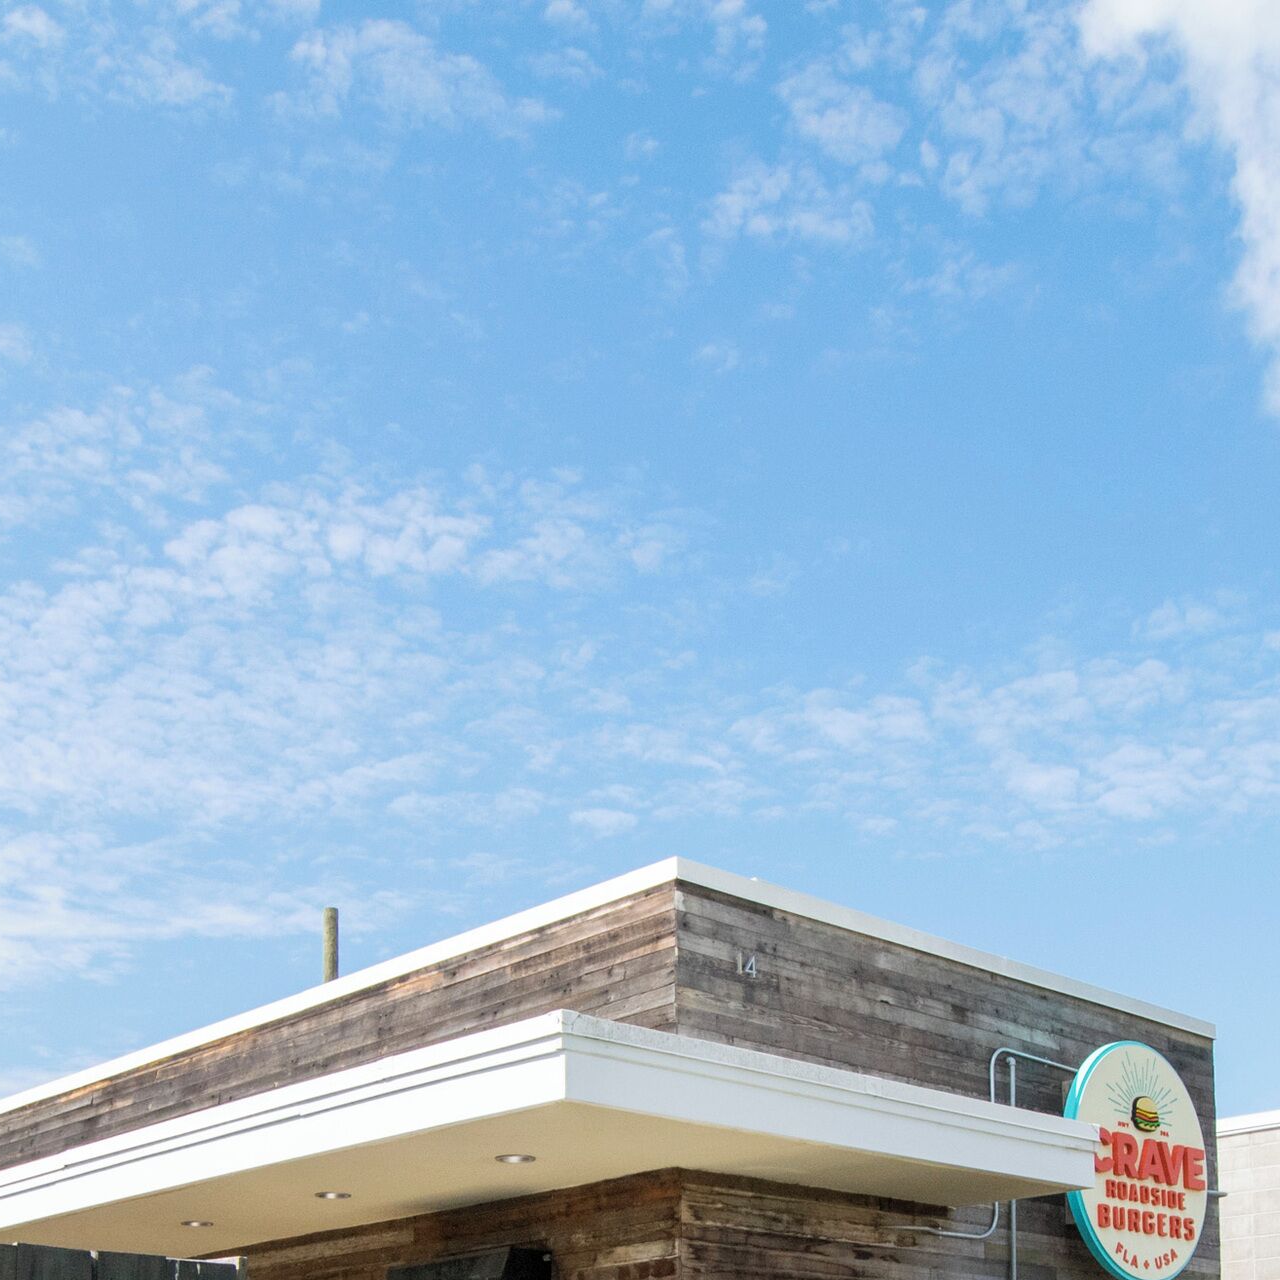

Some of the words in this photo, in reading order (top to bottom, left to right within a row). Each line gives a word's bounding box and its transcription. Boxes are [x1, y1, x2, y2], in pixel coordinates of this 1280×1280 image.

[736, 952, 756, 978] 14
[1095, 1127, 1206, 1191] CRAVE
[1105, 1179, 1186, 1211] ROADSIDE
[1097, 1203, 1195, 1242] BURGERS
[1116, 1242, 1138, 1269] FLA
[1155, 1248, 1178, 1269] USA
